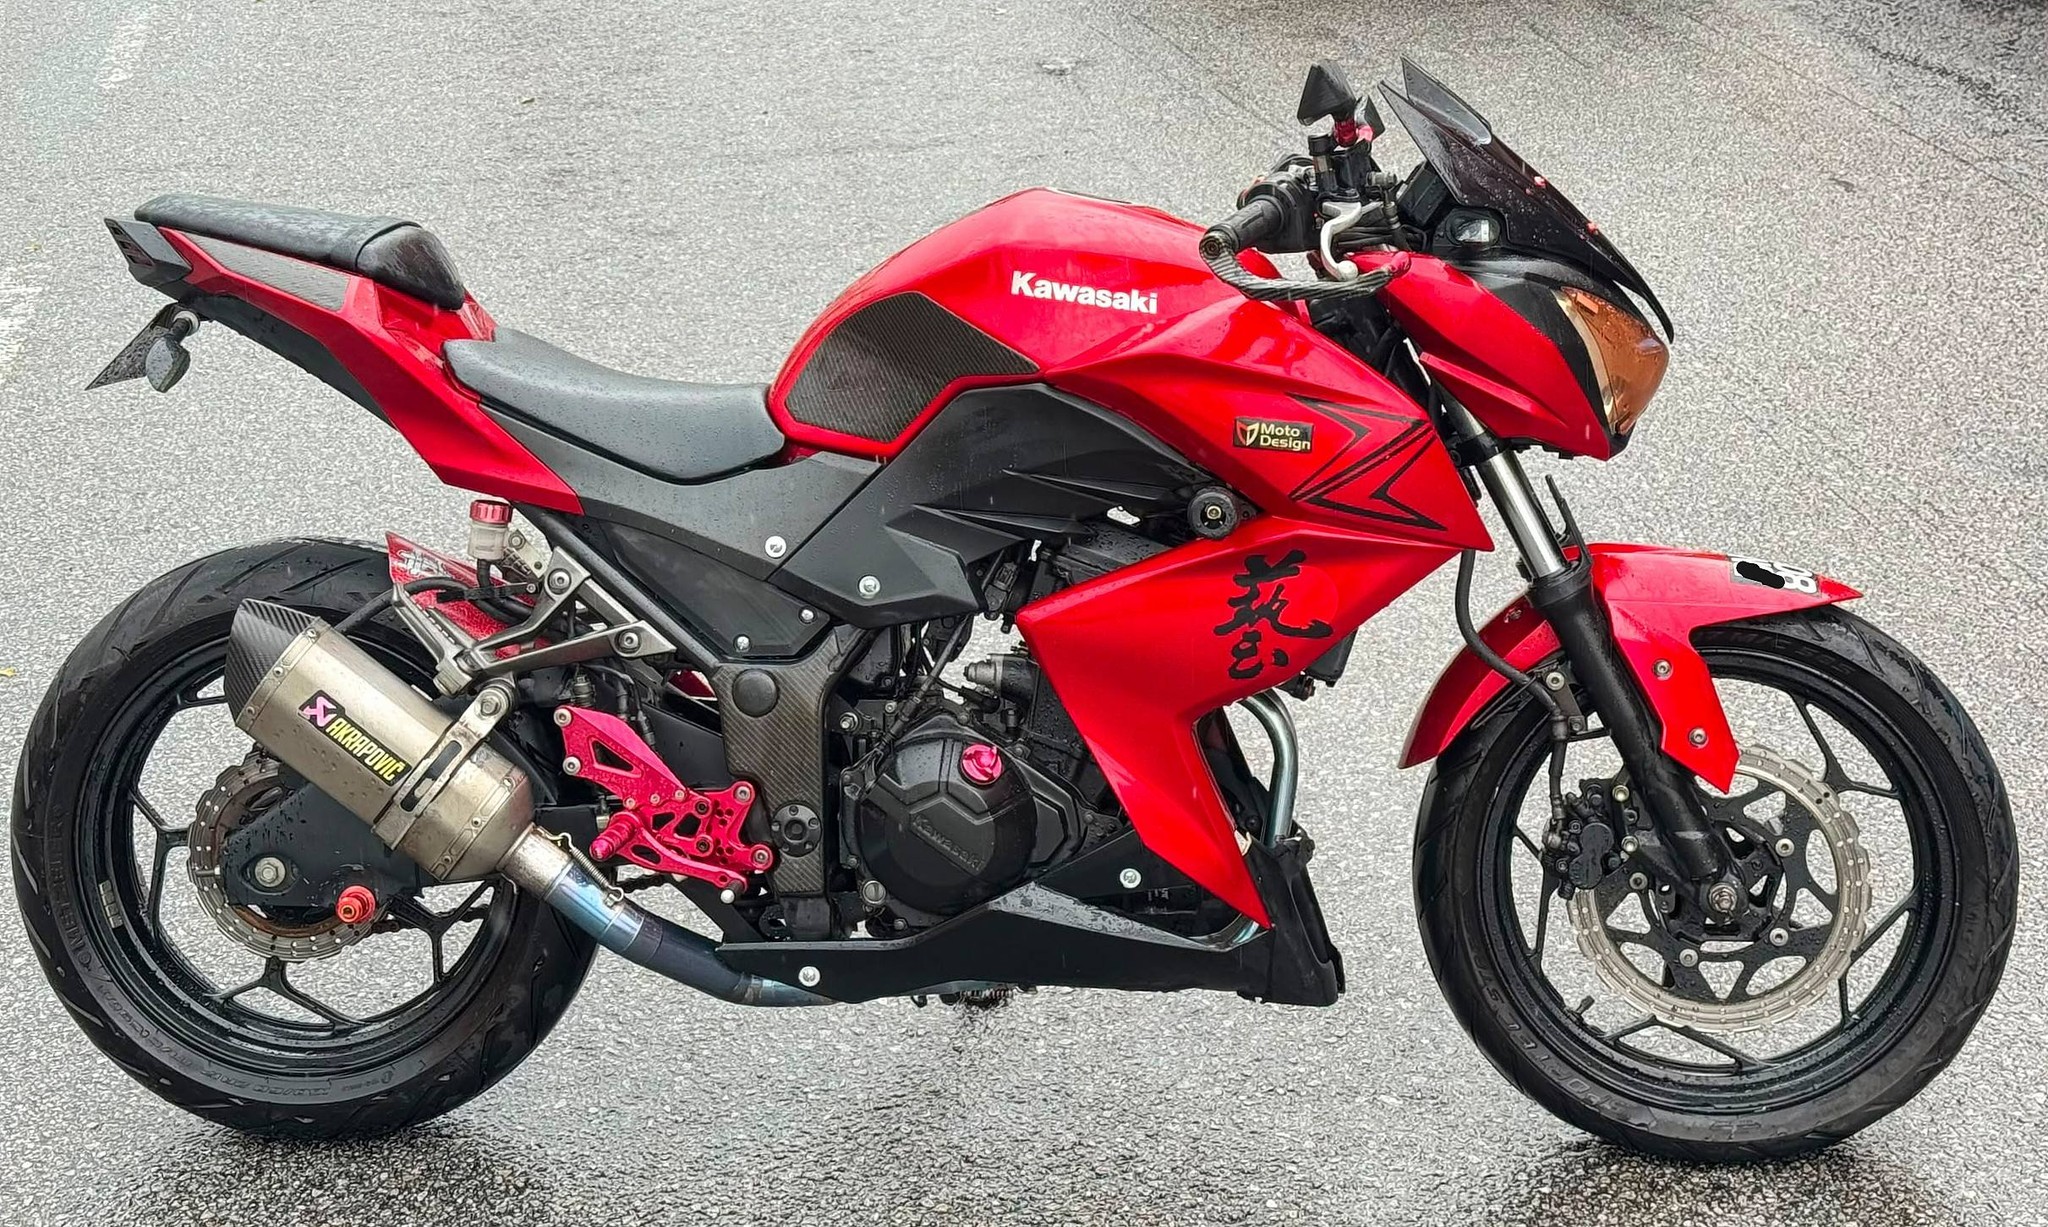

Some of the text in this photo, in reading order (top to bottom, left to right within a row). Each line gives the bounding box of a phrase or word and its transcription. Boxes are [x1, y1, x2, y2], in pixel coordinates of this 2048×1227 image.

[1010, 270, 1158, 314] Kawasaki
[1260, 422, 1300, 437] Moto
[1260, 434, 1311, 451] Design
[911, 814, 986, 872] Kawasaki
[1494, 1010, 1628, 1114] SPORTEC
